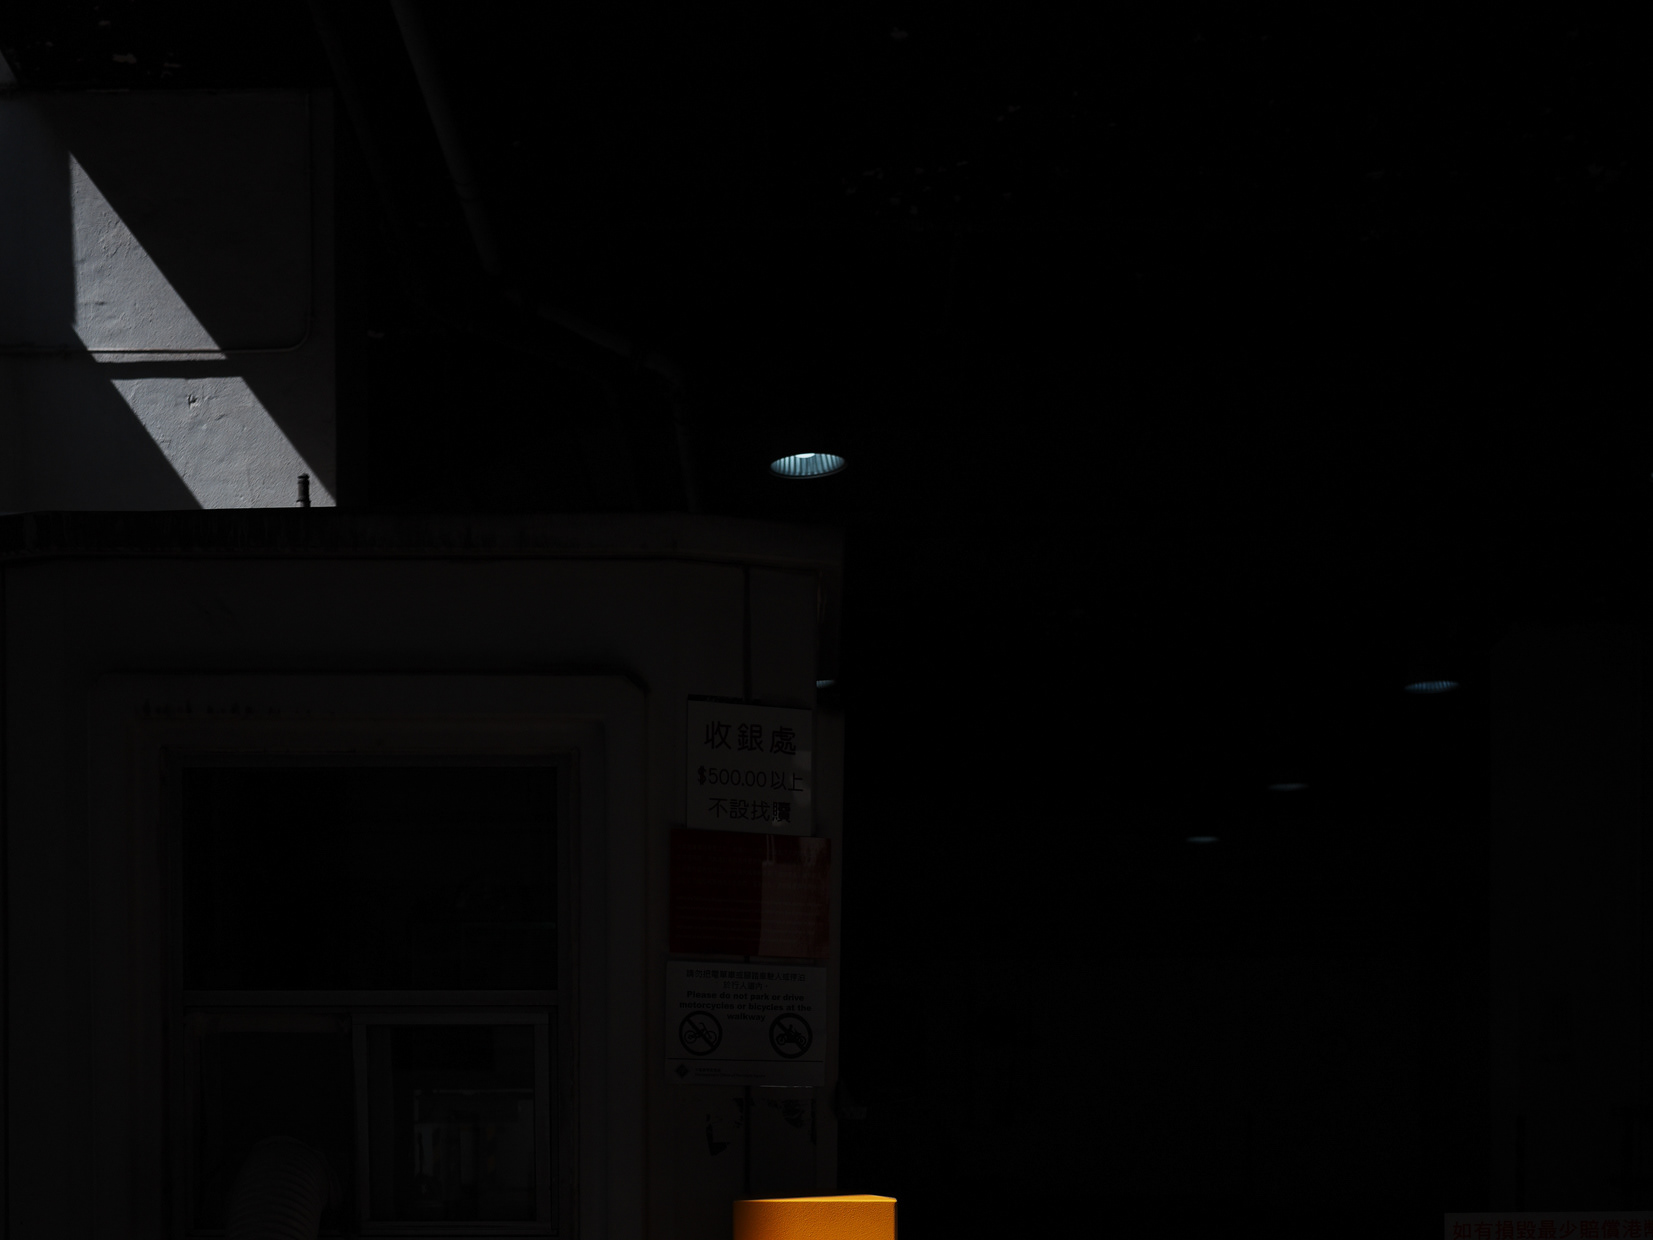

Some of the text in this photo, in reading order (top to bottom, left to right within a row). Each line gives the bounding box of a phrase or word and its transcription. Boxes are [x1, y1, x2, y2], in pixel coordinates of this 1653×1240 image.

[704, 721, 796, 756] 收銀處
[708, 797, 791, 823] 不設找贖
[687, 990, 717, 999] Please
[719, 991, 731, 1000] do
[733, 992, 747, 1000] not
[750, 993, 769, 1003] park
[783, 994, 804, 1002] drive
[679, 1002, 734, 1011] motorcycles
[748, 1003, 783, 1012] bicycles
[797, 1004, 812, 1012] the
[727, 1013, 766, 1022] walkway
